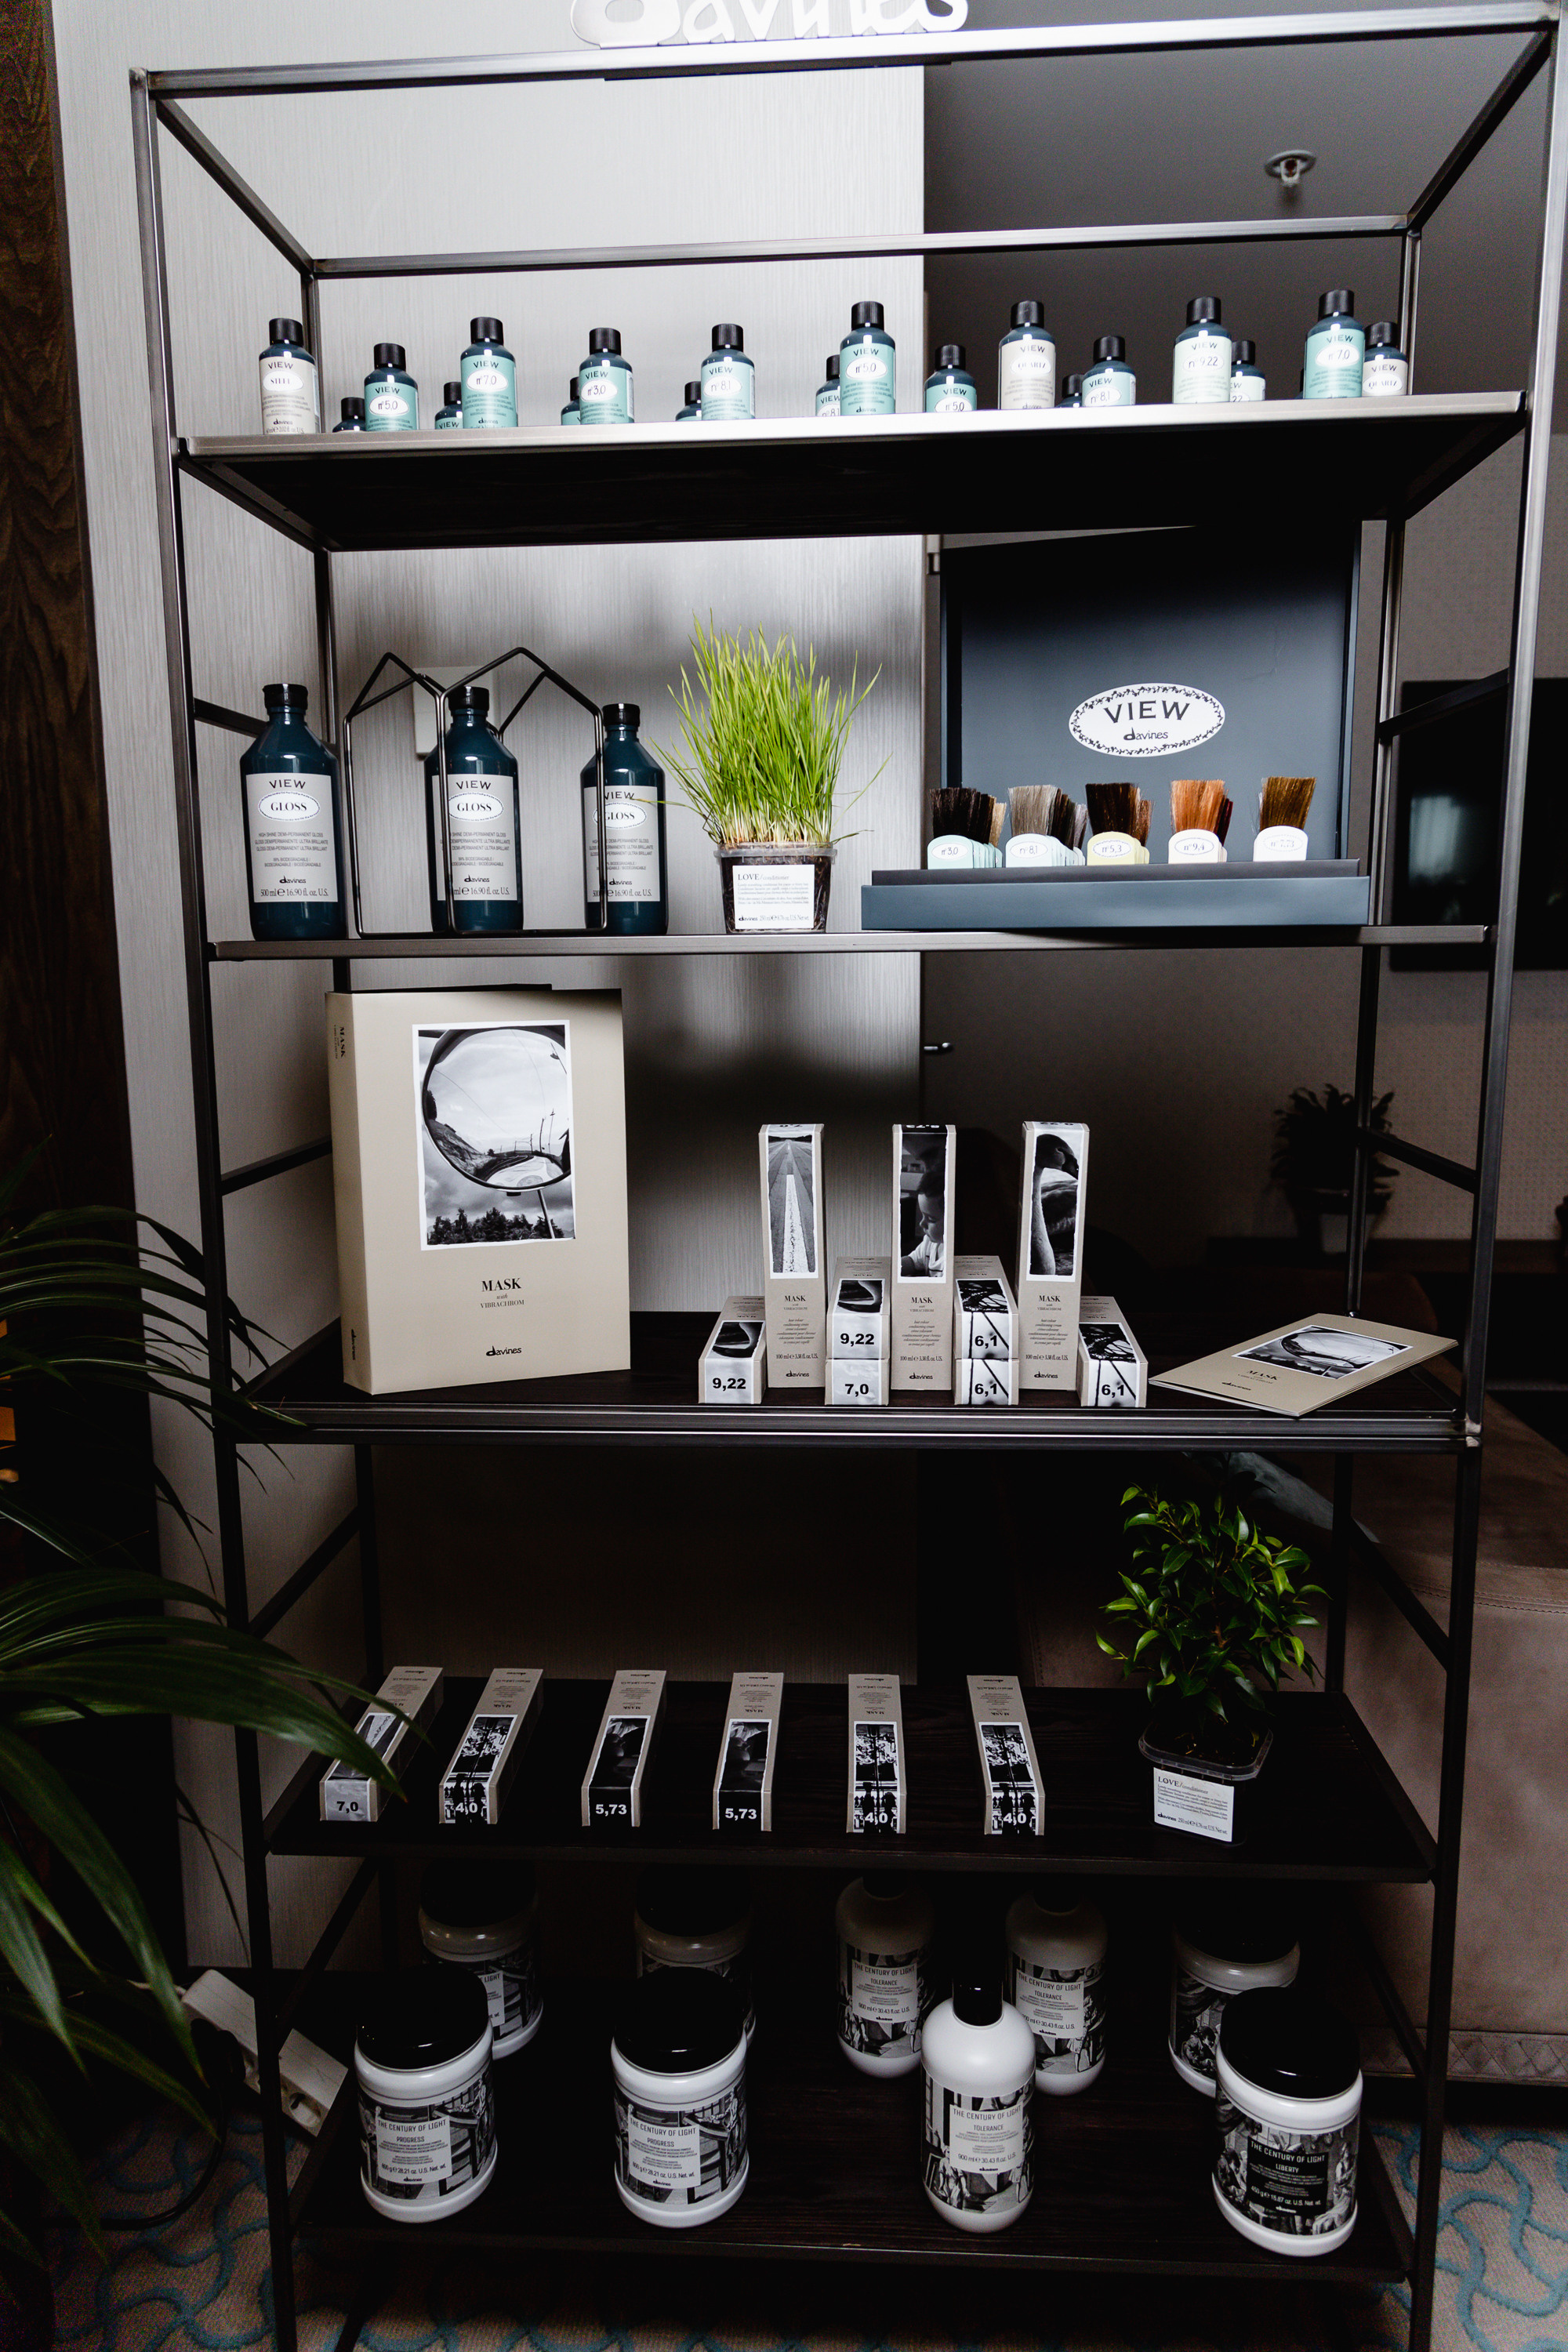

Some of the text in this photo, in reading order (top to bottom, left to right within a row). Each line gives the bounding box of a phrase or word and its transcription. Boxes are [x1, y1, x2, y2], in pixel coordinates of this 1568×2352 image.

[1327, 334, 1353, 343] VIEW
[1192, 342, 1217, 350] VIEW
[1371, 364, 1397, 372] VIEW
[585, 371, 608, 379] VIEW
[1089, 378, 1112, 387] VIEW
[1104, 700, 1190, 724] VIEW
[1123, 727, 1168, 741] davines
[268, 779, 306, 789] VIEW
[456, 780, 491, 789] VIEW
[604, 791, 634, 800] VIEW
[271, 801, 307, 811] GLOSS
[457, 803, 492, 811] GLOSS
[1183, 842, 1204, 851] n°9,4
[481, 1278, 521, 1292] MASK
[480, 1299, 524, 1308] VIBRACHROM
[840, 1334, 874, 1347] 9,22
[975, 1335, 997, 1348] 6,1
[486, 1345, 522, 1356] davines
[712, 1377, 746, 1391] 9,22
[844, 1384, 869, 1397] 7,0
[975, 1384, 997, 1396] 6,1
[1102, 1385, 1124, 1398] 6,1
[336, 1801, 358, 1813] 7,0
[595, 1804, 627, 1817] 5,73
[724, 1808, 757, 1821] 5,73
[1157, 1813, 1176, 1821] davines
[900, 1966, 914, 1976] LIGHT
[1018, 1973, 1027, 1982] THE
[1029, 1977, 1054, 1990] CENTURY
[1035, 1991, 1062, 2000] TOLERANCE
[953, 2108, 964, 2117] THE
[966, 2112, 996, 2121] CENTURY
[1007, 2105, 1022, 2117] LIGHT
[378, 2120, 387, 2129] THE
[389, 2123, 416, 2132] CENTURY
[428, 2119, 446, 2129] LIGHT
[640, 2124, 666, 2136] CENTURY
[648, 2137, 674, 2147] PROGRESS
[1250, 2141, 1262, 2151] THE
[1264, 2147, 1294, 2162] CENTURY
[1276, 2163, 1299, 2173] LIBERTY
